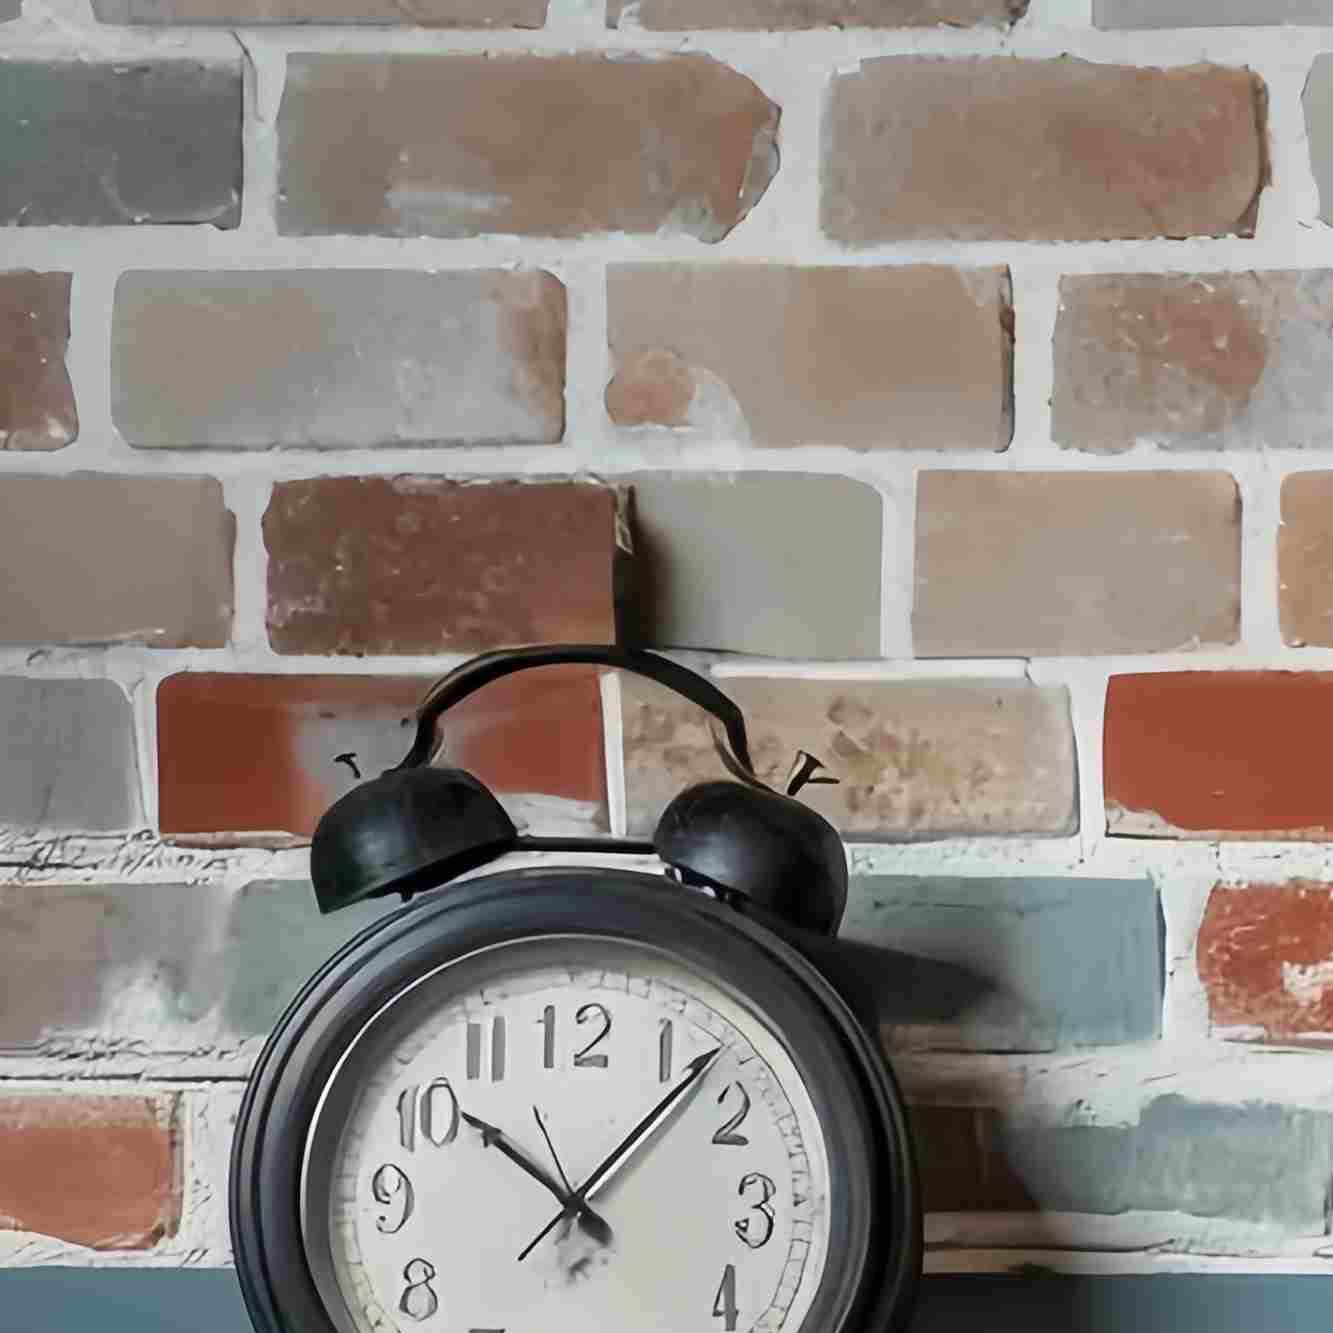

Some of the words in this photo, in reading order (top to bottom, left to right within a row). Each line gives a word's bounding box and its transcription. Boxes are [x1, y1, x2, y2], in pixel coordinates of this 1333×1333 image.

[466, 1015, 507, 1081] 11
[536, 1002, 612, 1069] 12
[658, 1018, 673, 1082] 1
[395, 1076, 461, 1152] 10
[711, 1081, 751, 1146] 2
[372, 1163, 414, 1234] 9
[735, 1173, 776, 1248] 3
[399, 1258, 438, 1321] 8
[711, 1264, 739, 1331] 4
